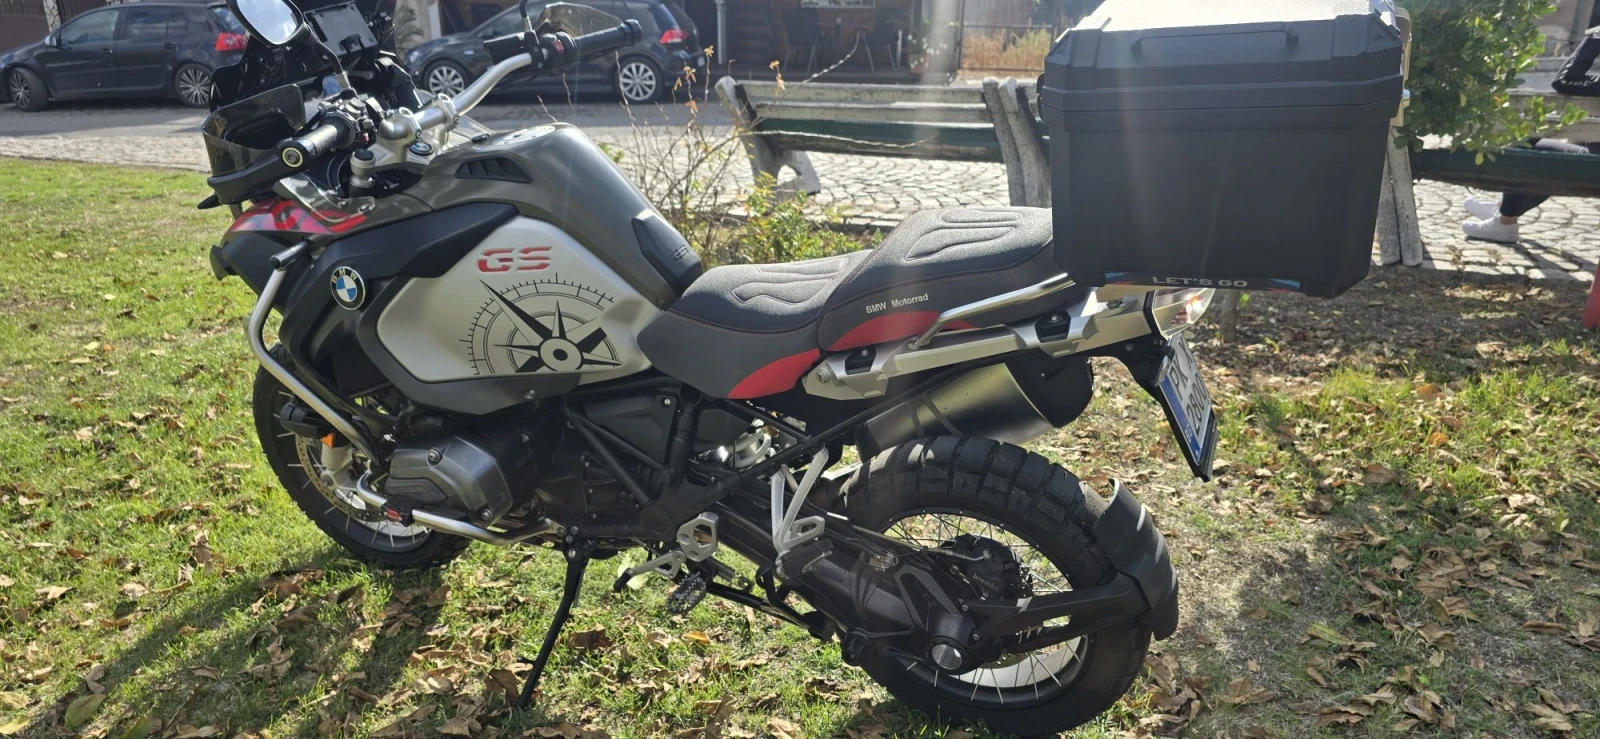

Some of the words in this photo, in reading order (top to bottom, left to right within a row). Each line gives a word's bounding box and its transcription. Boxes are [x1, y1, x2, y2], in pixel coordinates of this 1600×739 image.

[477, 246, 553, 273] GS
[331, 268, 358, 284] BMW
[1152, 276, 1213, 286] LET'S
[1217, 279, 1248, 288] GO
[865, 301, 887, 314] BMW
[891, 292, 930, 308] Motorrad
[1170, 352, 1188, 400] PK
[1187, 372, 1207, 436] 2800
